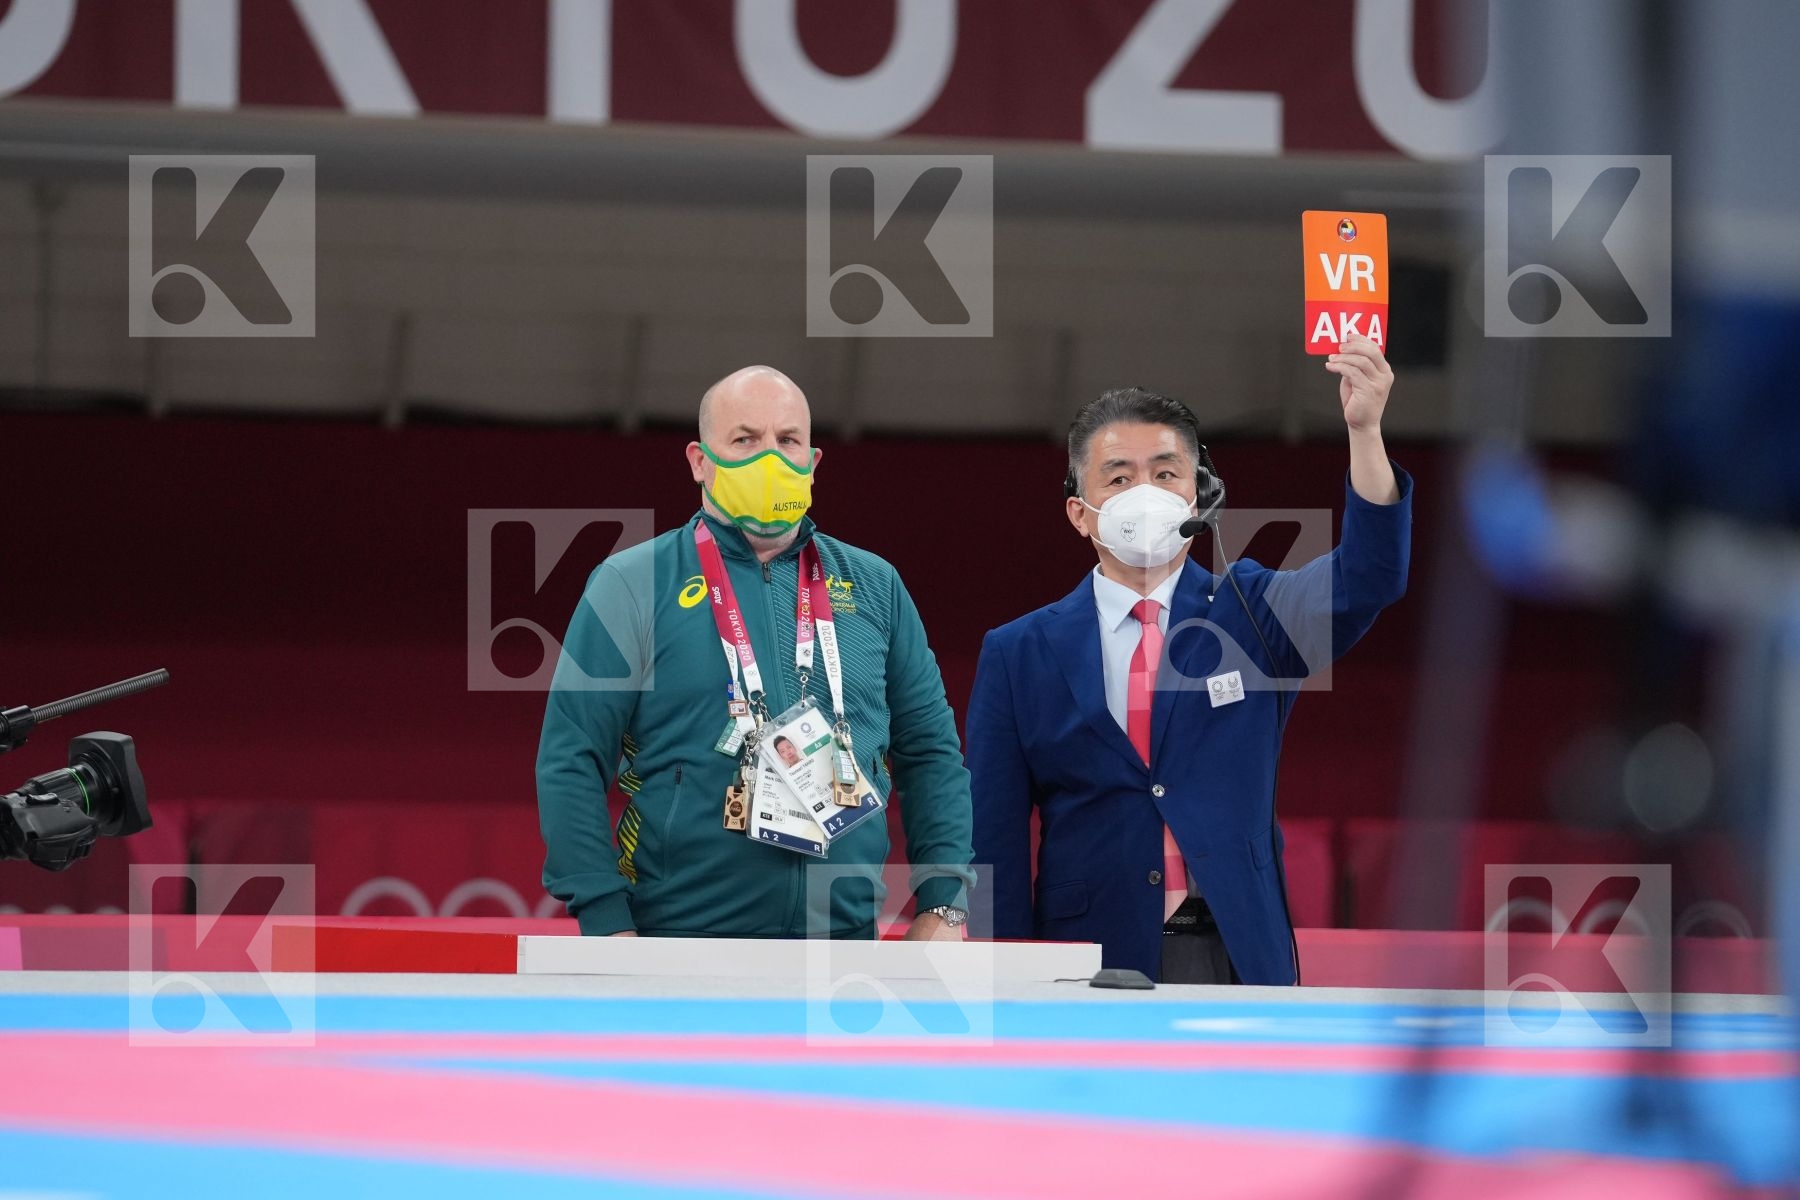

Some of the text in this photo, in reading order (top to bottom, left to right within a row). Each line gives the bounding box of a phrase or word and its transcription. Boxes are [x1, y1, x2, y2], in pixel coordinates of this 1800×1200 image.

[1320, 253, 1376, 292] VR
[1311, 312, 1383, 346] AKA
[801, 587, 810, 615] TOKO
[728, 608, 751, 661] TOKYO 2020
[822, 625, 839, 679] TOKYO 2020
